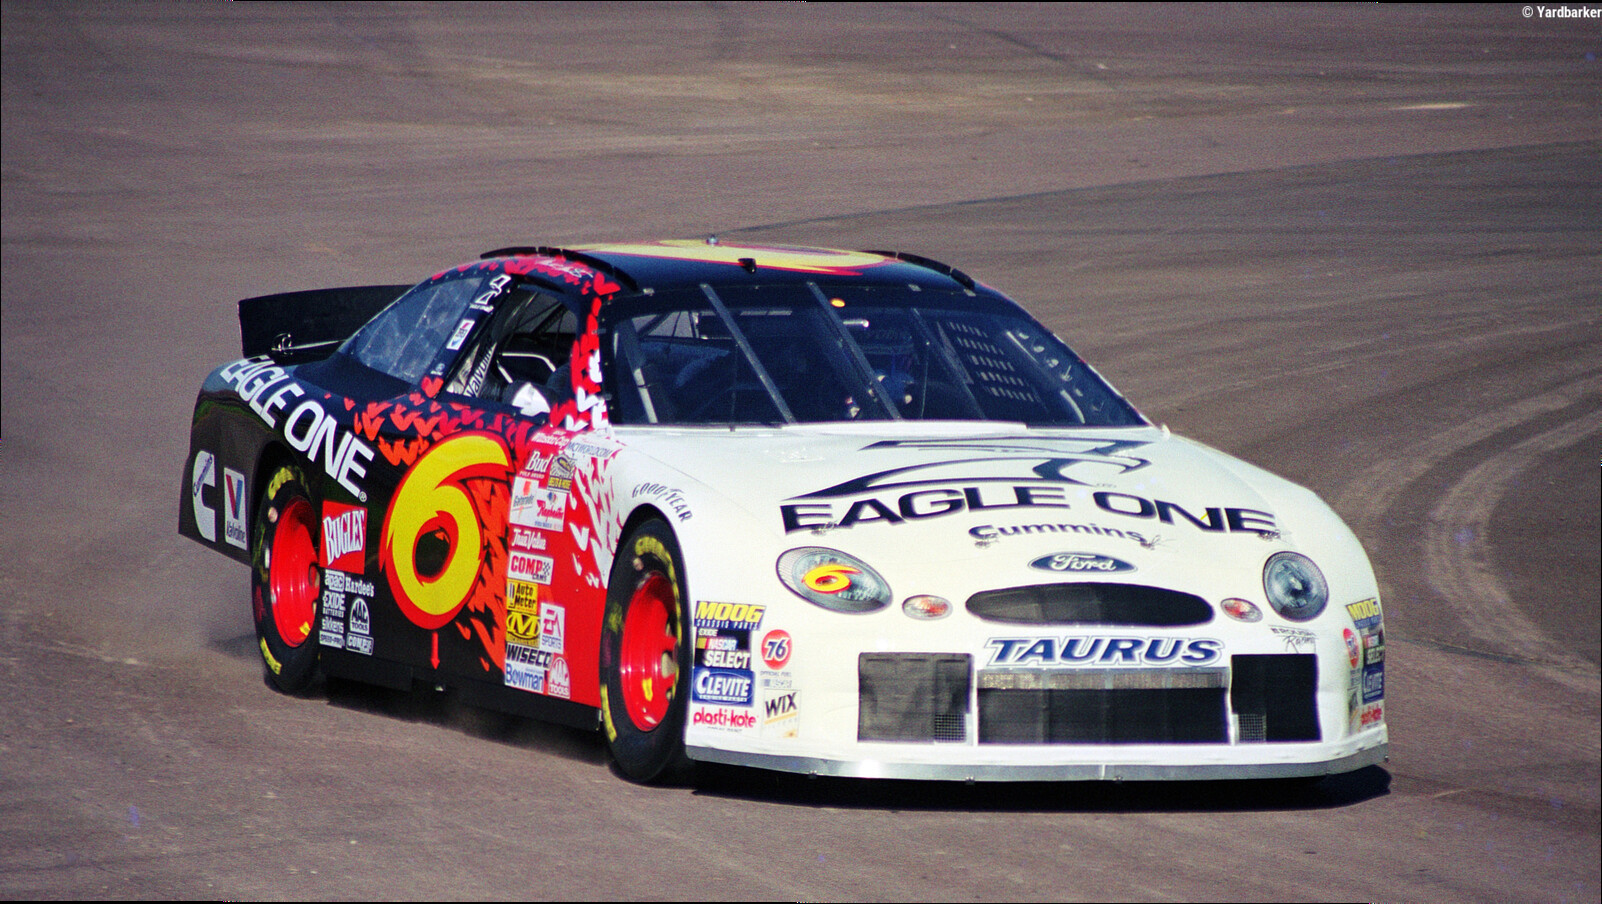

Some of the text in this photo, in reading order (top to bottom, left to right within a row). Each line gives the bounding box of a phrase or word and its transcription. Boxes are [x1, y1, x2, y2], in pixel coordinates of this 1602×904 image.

[220, 355, 305, 428] EAGLE
[525, 450, 554, 473] Bud
[780, 486, 1277, 536] EAGLE ONE
[323, 510, 365, 566] BUGLES
[379, 430, 515, 630] 6
[968, 523, 1148, 543] Cummins
[511, 554, 543, 575] COMP
[1051, 554, 1116, 571] Ford
[345, 576, 374, 597] Hardee's
[516, 582, 534, 596] Auto
[801, 563, 863, 594] 6
[323, 590, 346, 611] EXIDE
[515, 596, 536, 609] Meter
[1347, 598, 1380, 621] MOOG
[695, 601, 766, 623] MOOG
[352, 621, 368, 631] TOOLS
[696, 619, 760, 631] CHASSIS PARTS
[506, 643, 552, 669] WISECO
[704, 650, 750, 669] SELECT
[764, 638, 791, 662] 76
[986, 636, 1224, 666] TAURUS
[506, 663, 543, 691] Bowman
[696, 670, 751, 697] CLEVITE
[550, 683, 569, 696] TOOLS
[765, 692, 797, 718] WIX
[693, 707, 757, 729] plasti-kote
